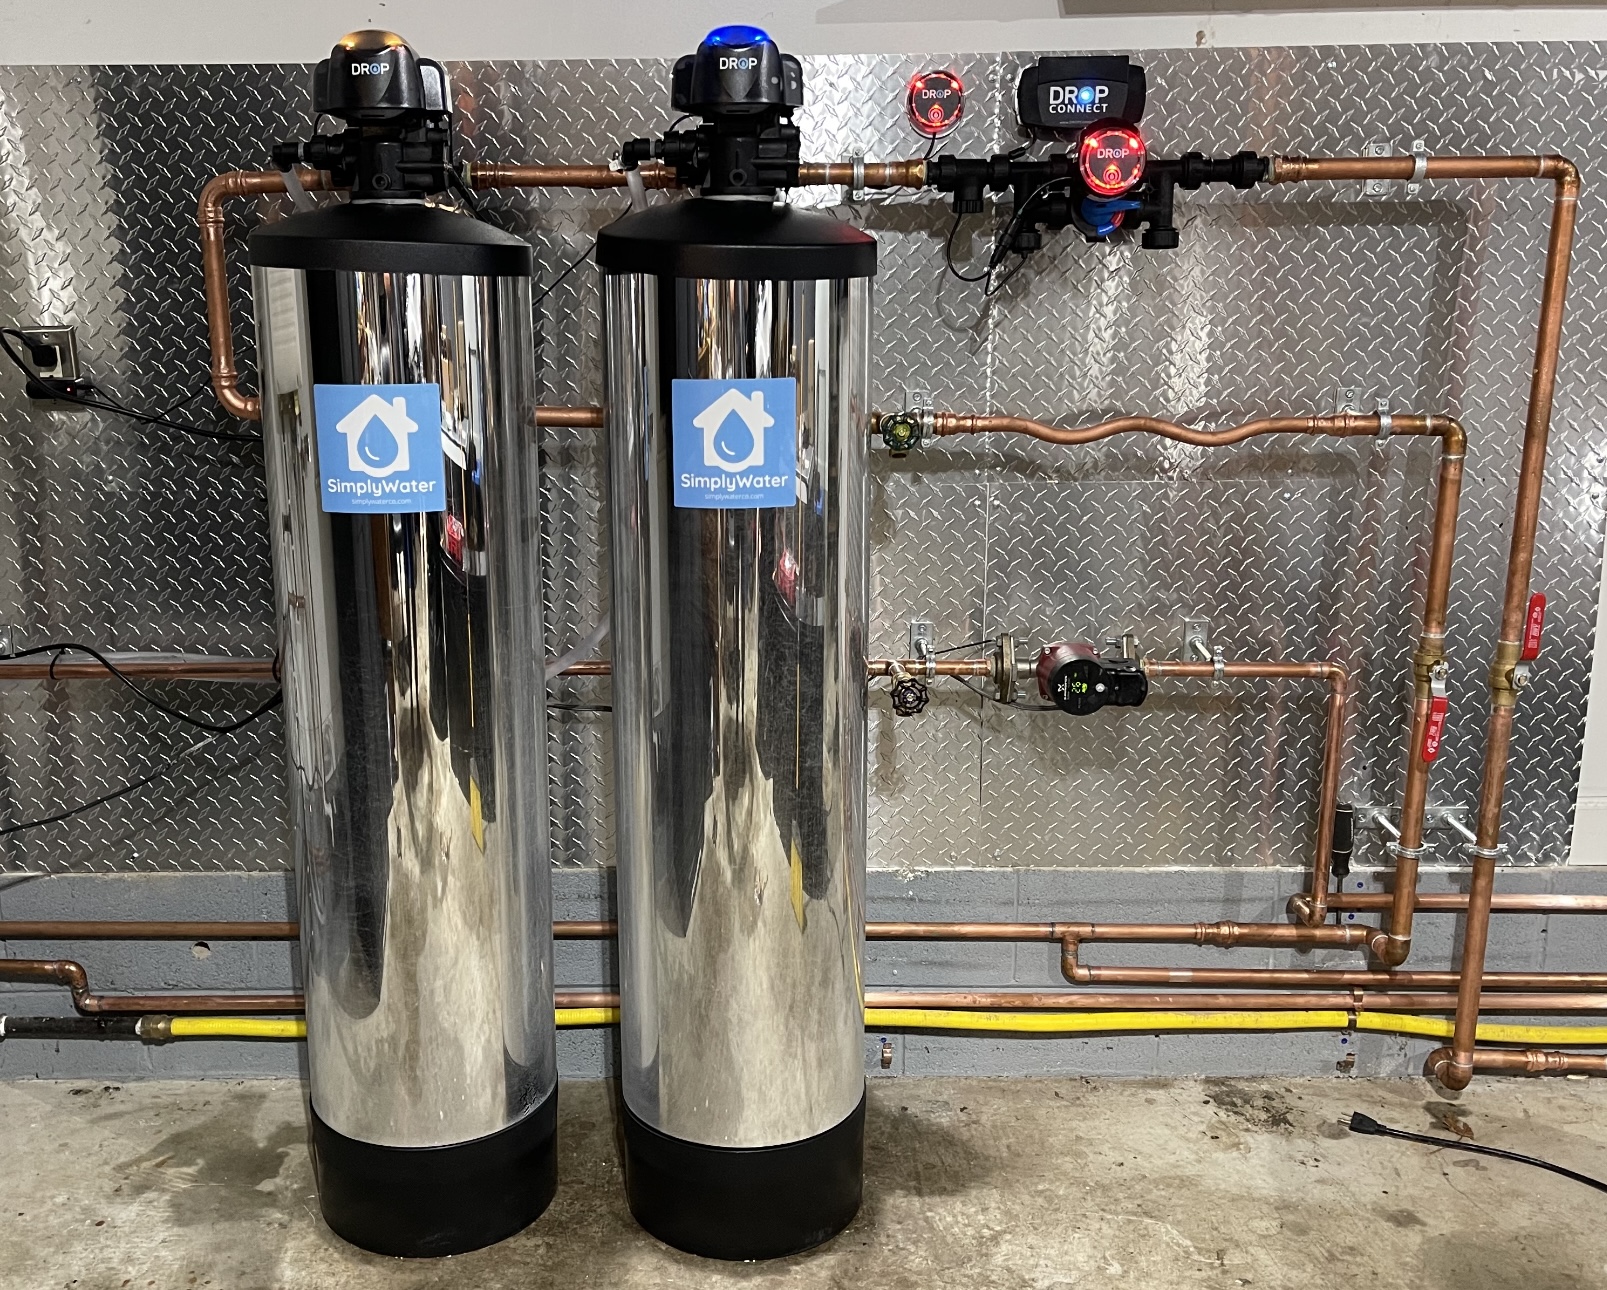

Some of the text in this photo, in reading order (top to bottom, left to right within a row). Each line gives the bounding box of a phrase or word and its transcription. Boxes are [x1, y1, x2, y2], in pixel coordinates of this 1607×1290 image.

[719, 57, 757, 70] DROP
[351, 63, 389, 75] DROP
[922, 90, 951, 98] DROP
[1049, 86, 1109, 104] DROP
[1049, 104, 1108, 113] CONNECT
[1097, 149, 1129, 158] DROP
[328, 479, 436, 496] SimplyWater
[681, 474, 788, 492] SimplyWater
[352, 498, 411, 506] simplywaterco.com
[705, 493, 764, 501] simplywaterco.com
